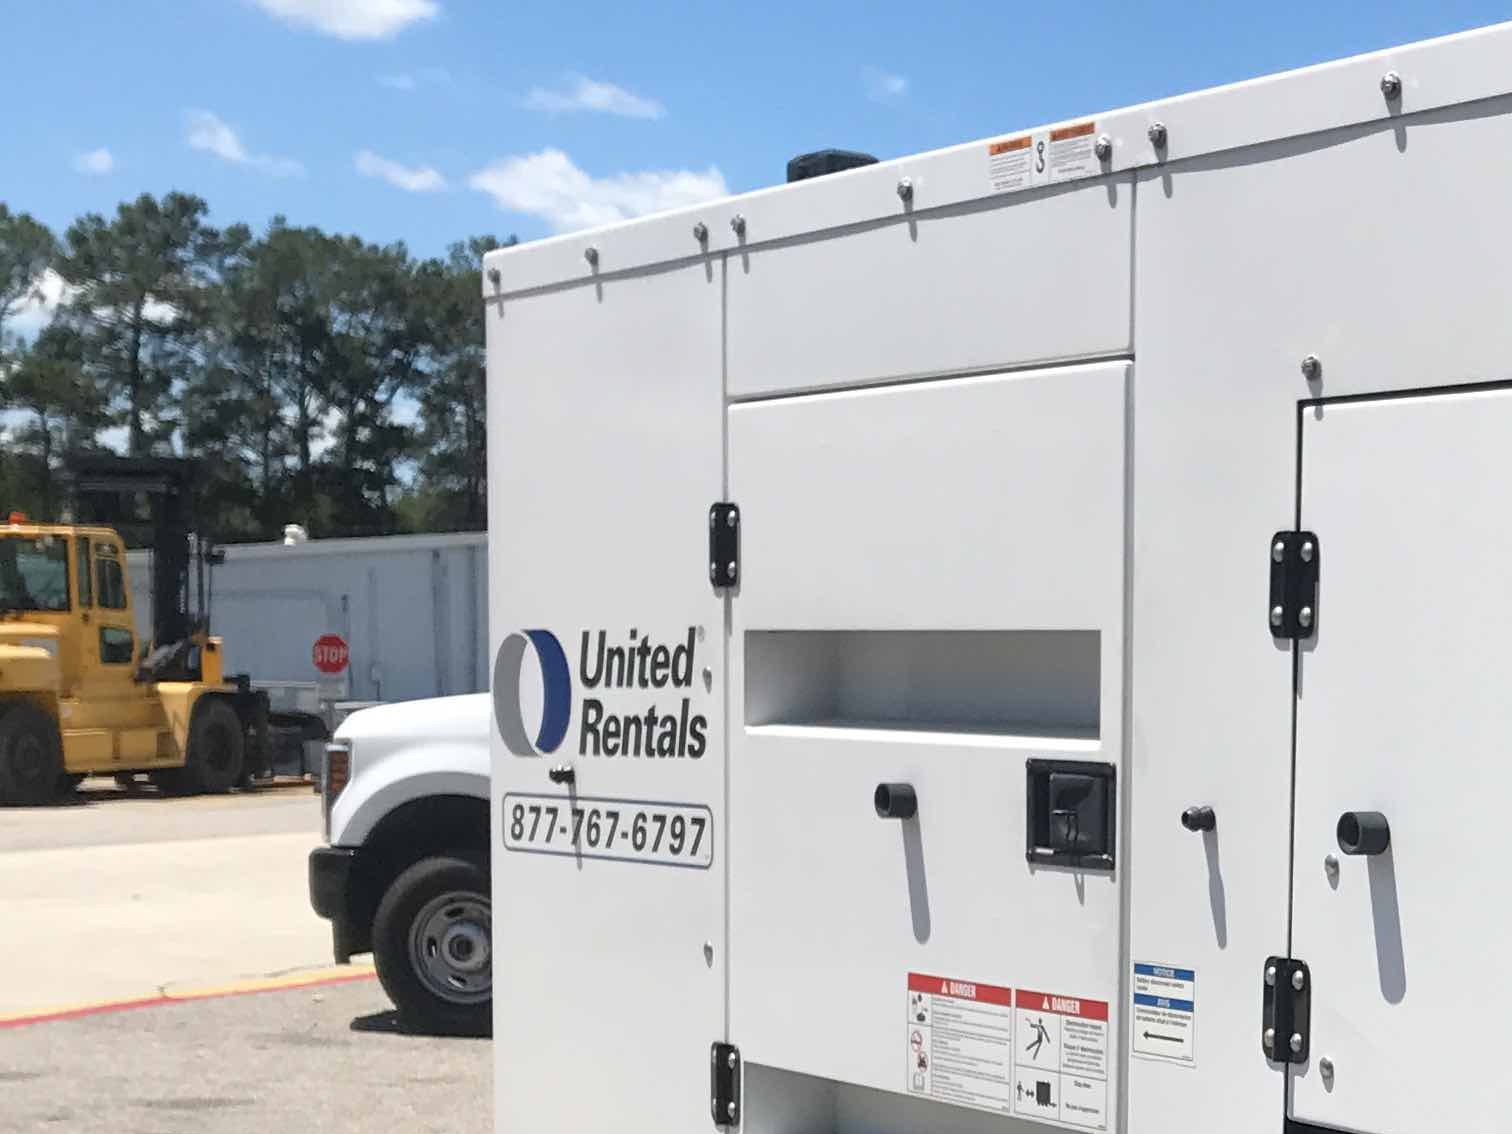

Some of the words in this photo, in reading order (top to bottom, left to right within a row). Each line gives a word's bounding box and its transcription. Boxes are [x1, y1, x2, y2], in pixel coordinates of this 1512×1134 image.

[579, 626, 696, 689] United
[578, 697, 708, 759] Rentals
[510, 803, 706, 857] 877-767-6797
